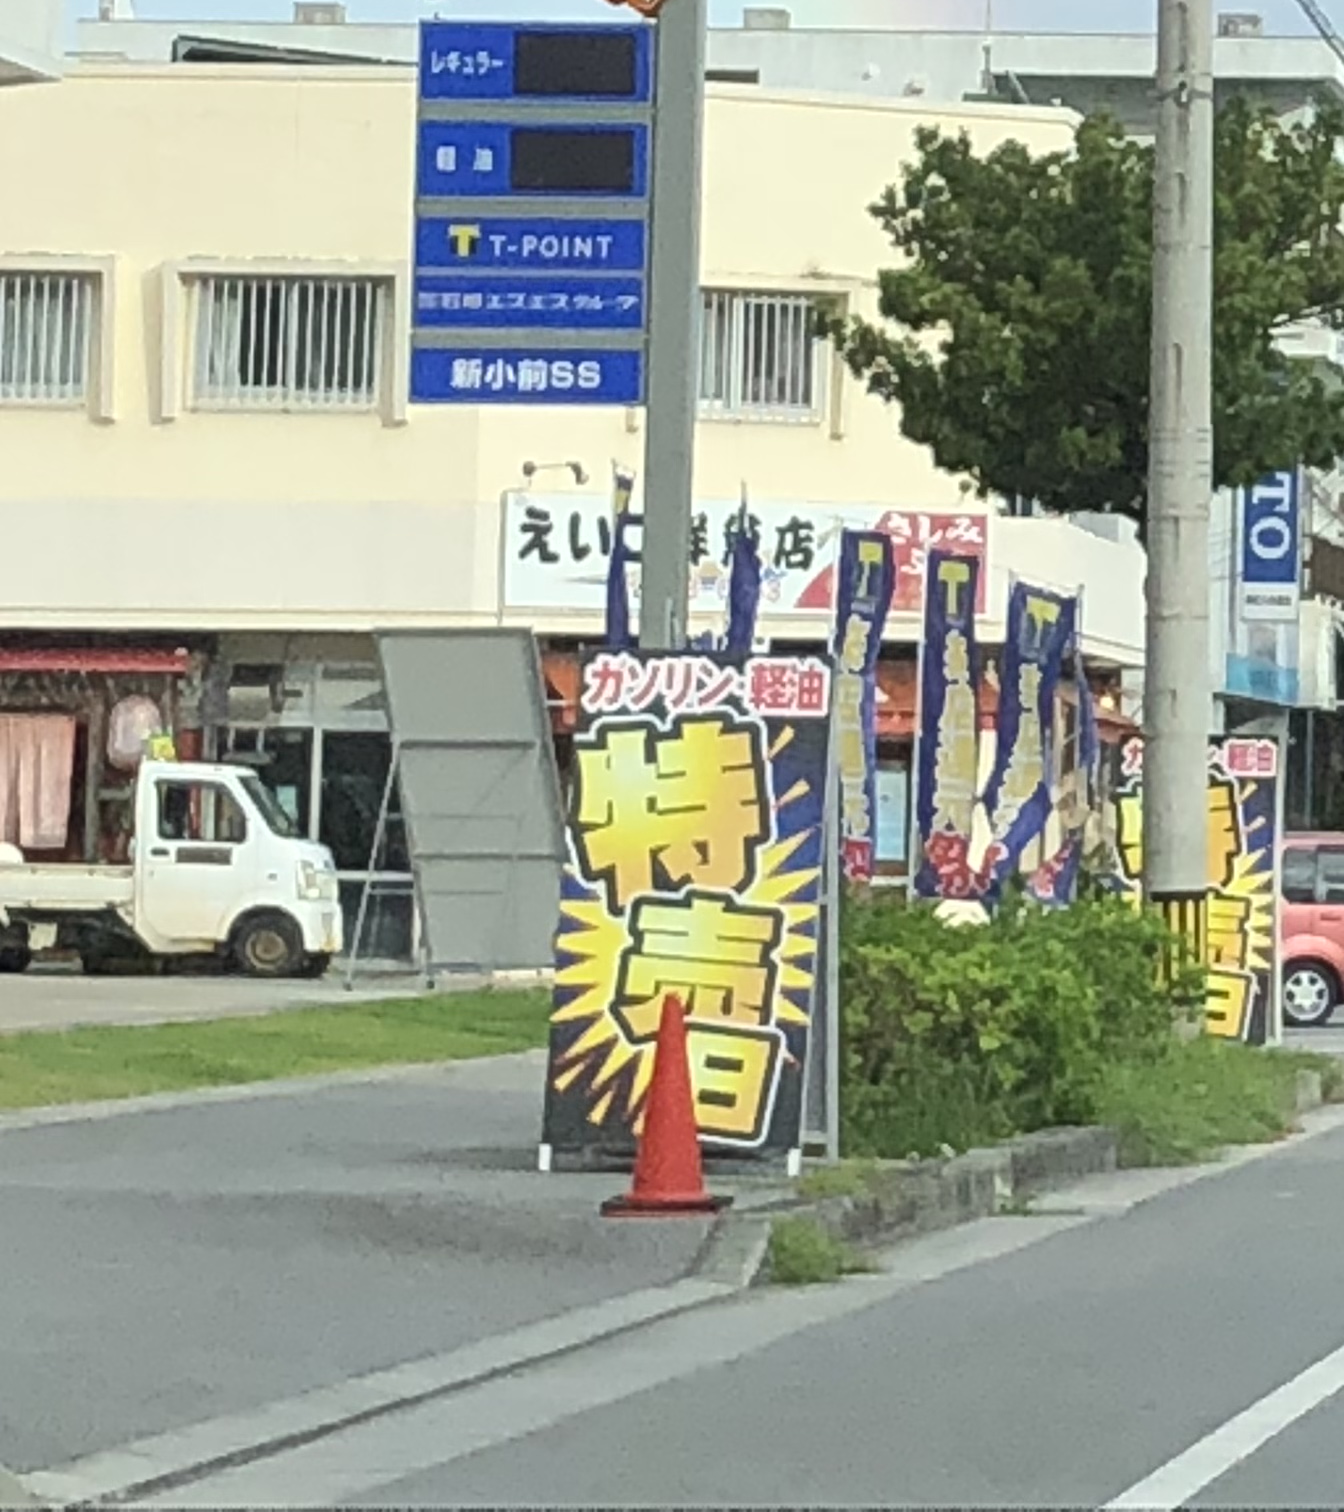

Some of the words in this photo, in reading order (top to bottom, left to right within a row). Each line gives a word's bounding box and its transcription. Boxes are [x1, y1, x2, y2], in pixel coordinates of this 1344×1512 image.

[431, 50, 504, 75] レギュラー
[489, 235, 613, 258] T-POINT
[587, 661, 825, 710] ガソリン・軽油
